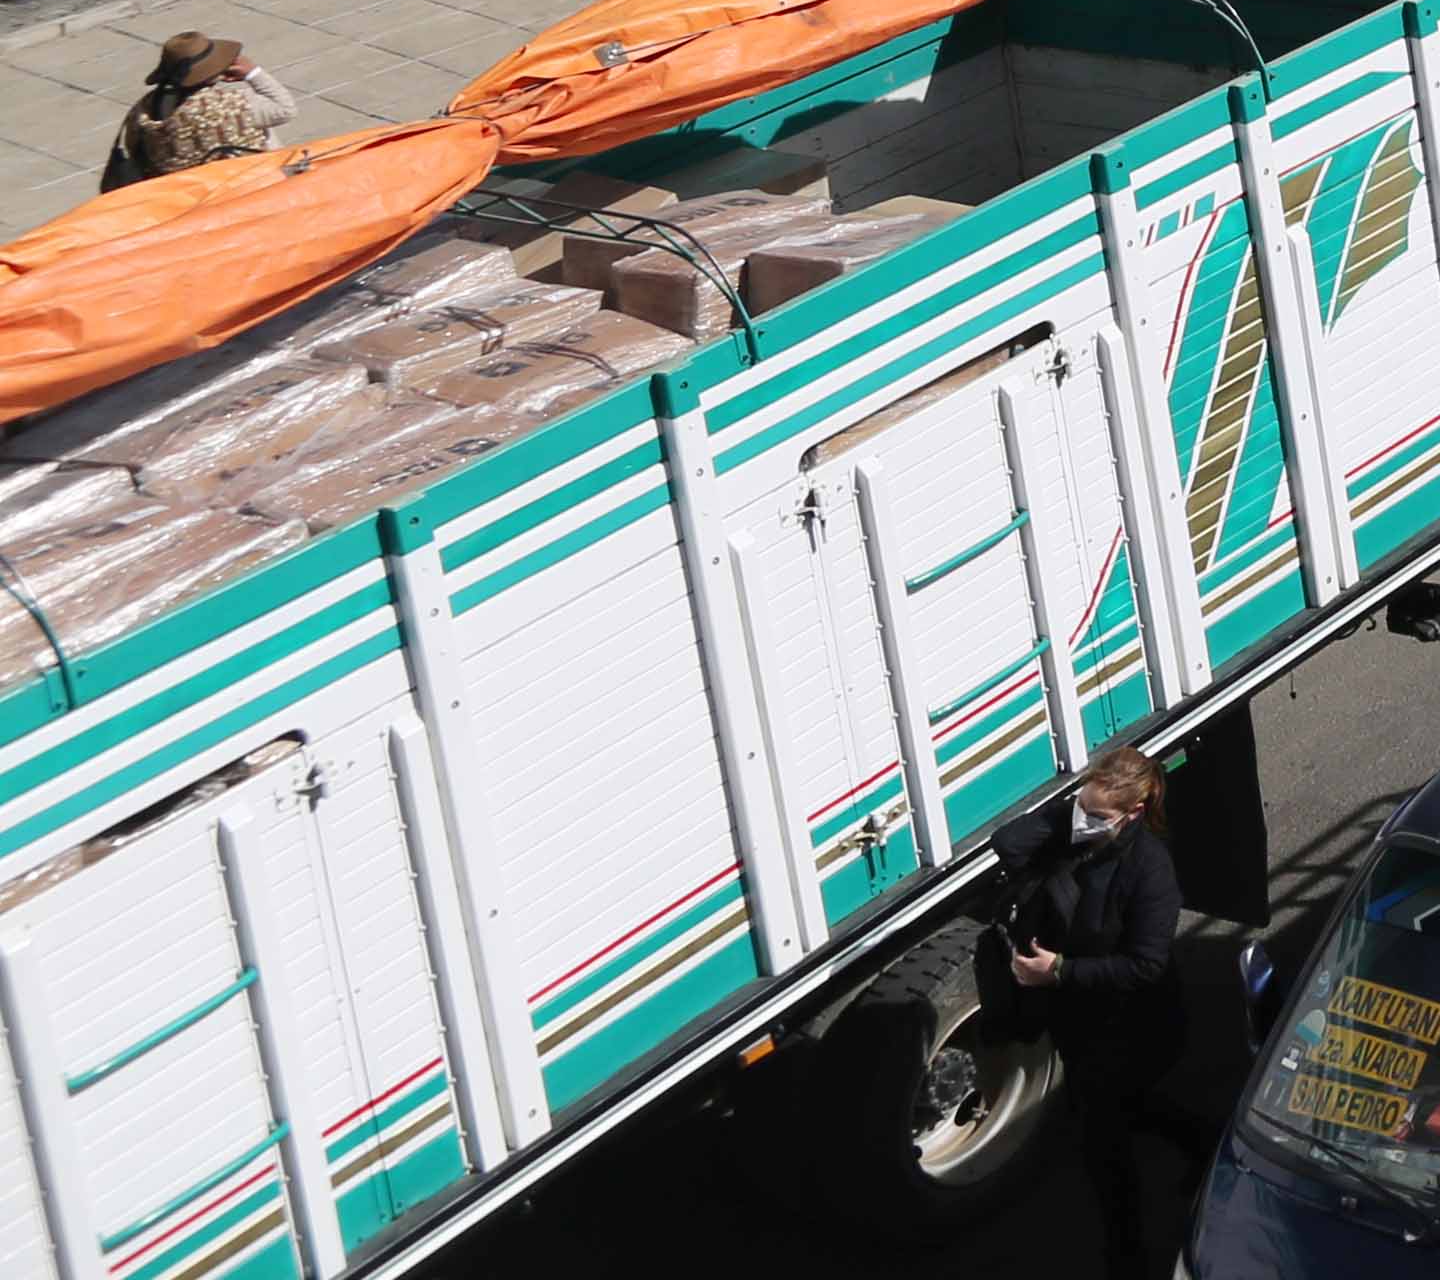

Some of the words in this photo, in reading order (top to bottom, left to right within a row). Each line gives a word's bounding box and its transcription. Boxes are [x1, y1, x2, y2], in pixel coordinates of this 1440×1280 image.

[1350, 1038, 1420, 1090] AVAROA
[1292, 1078, 1332, 1115] SAN
[1333, 1086, 1402, 1132] PEDRO
